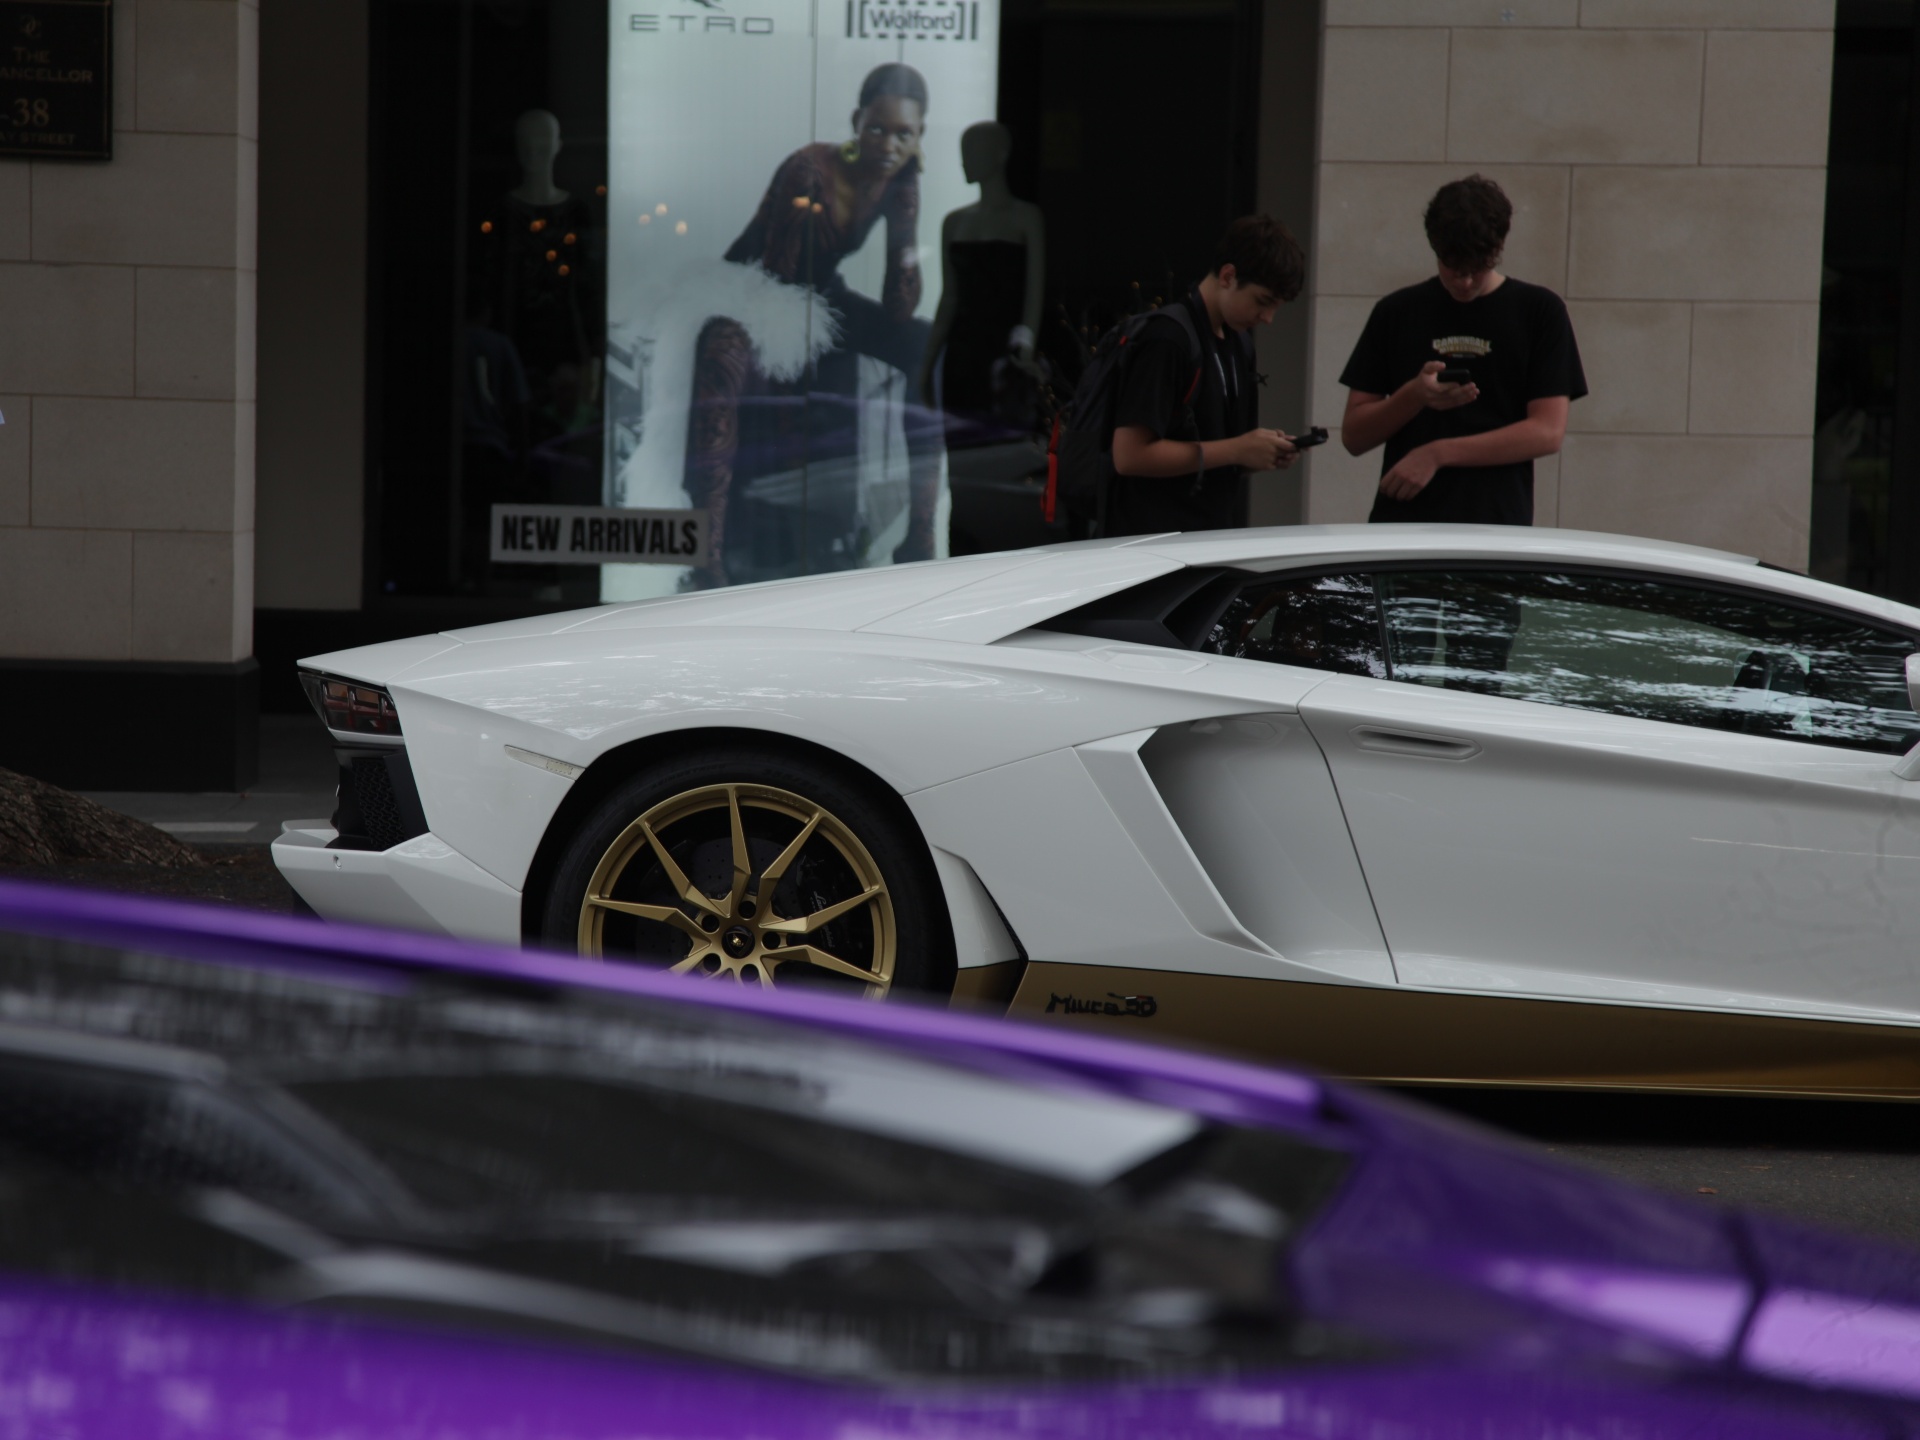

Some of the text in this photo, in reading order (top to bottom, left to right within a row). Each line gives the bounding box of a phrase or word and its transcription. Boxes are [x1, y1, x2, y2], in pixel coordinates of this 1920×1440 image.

[629, 14, 774, 34] ETRO
[869, 9, 955, 30] Wolford
[12, 46, 51, 63] THE
[501, 514, 698, 555] NEW ARRIVALS
